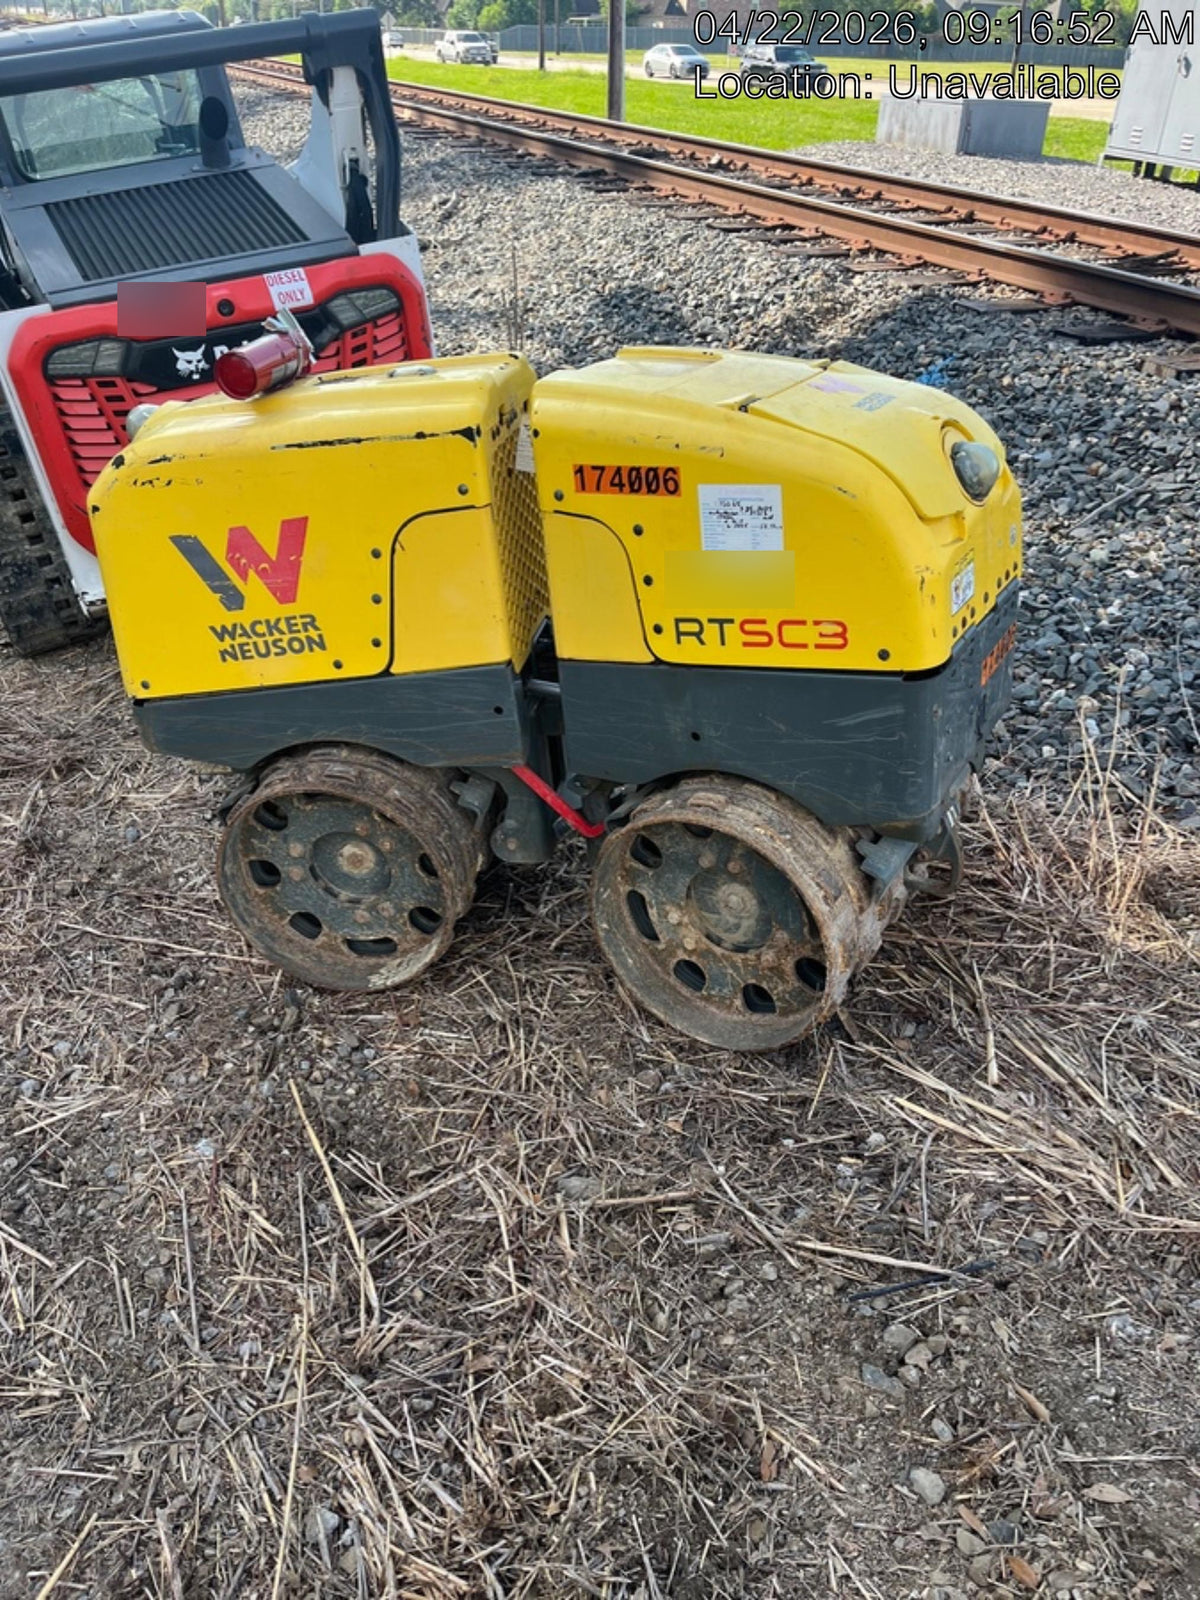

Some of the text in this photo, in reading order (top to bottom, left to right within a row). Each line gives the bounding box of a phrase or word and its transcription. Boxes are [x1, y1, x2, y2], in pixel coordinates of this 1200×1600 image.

[266, 269, 305, 287] DIESEL
[277, 288, 306, 305] ONLY
[574, 464, 679, 495] 174006
[208, 613, 321, 643] WACKER
[674, 617, 849, 650] RTSC3
[218, 632, 328, 663] NEUSON
